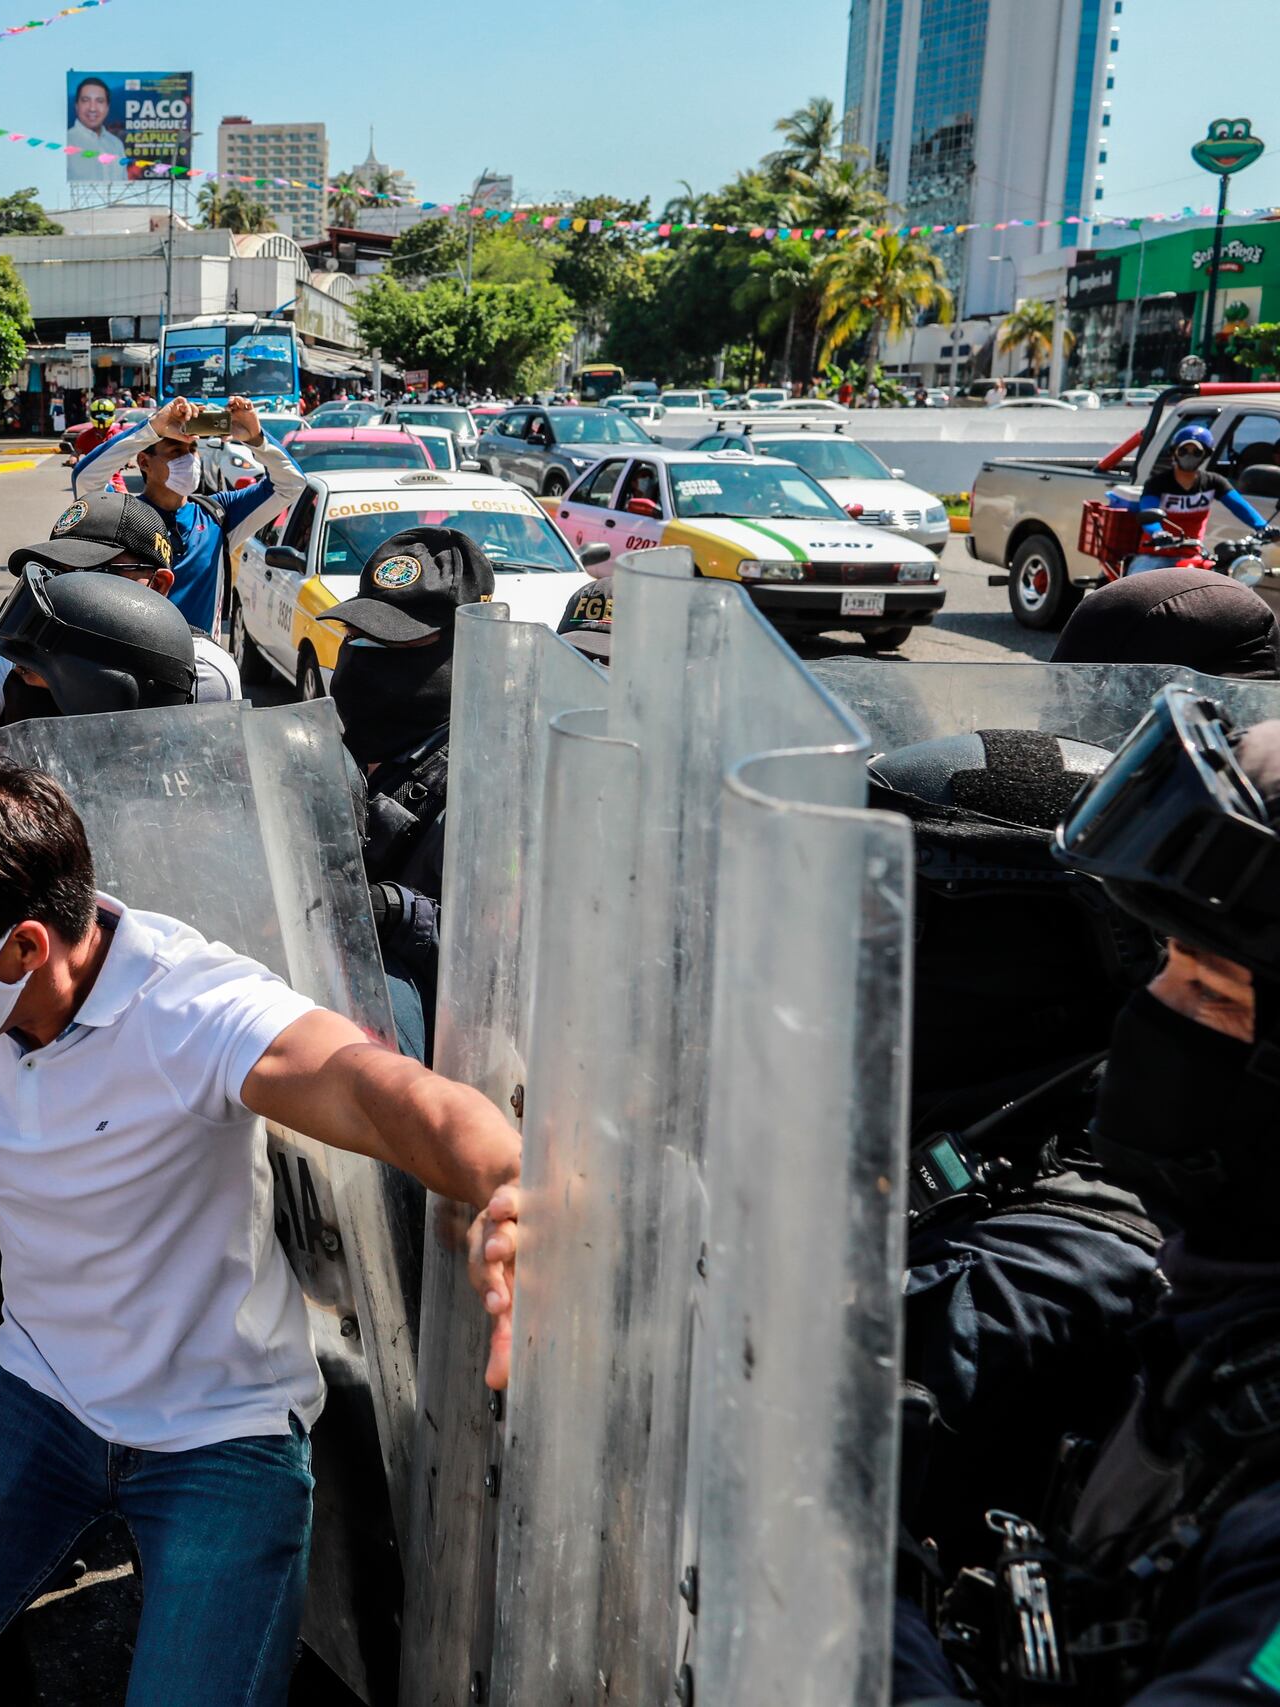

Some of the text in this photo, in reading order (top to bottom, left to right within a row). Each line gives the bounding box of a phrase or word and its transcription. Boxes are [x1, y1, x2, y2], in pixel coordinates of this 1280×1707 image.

[125, 100, 187, 119] PACO
[125, 133, 178, 143] ACAPULC
[677, 479, 720, 488] COSTERA
[681, 486, 723, 496] COLOSIO
[1165, 494, 1210, 509] FILA
[328, 499, 539, 518] COLOSIO COSTERA
